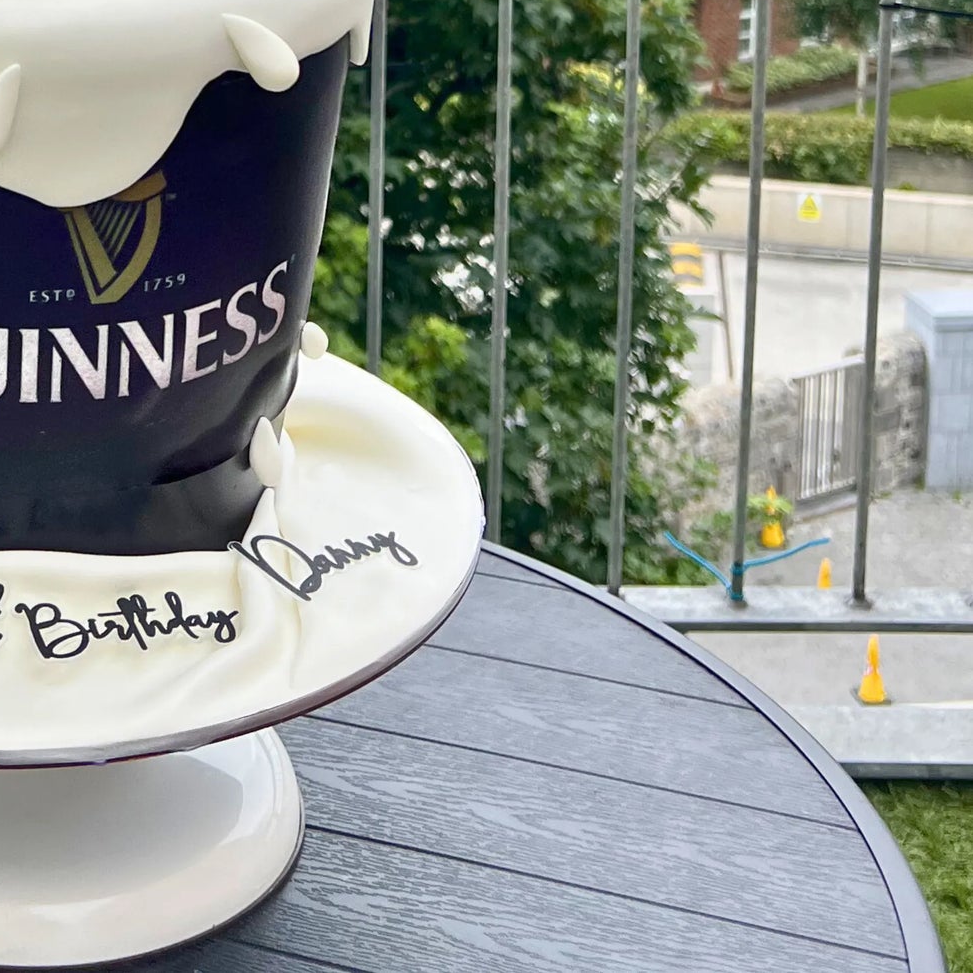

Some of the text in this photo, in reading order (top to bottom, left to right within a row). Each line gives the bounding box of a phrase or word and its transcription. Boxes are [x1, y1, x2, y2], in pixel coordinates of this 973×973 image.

[143, 272, 187, 292] 1759
[233, 526, 417, 601] Danny
[15, 591, 240, 659] Birthday
